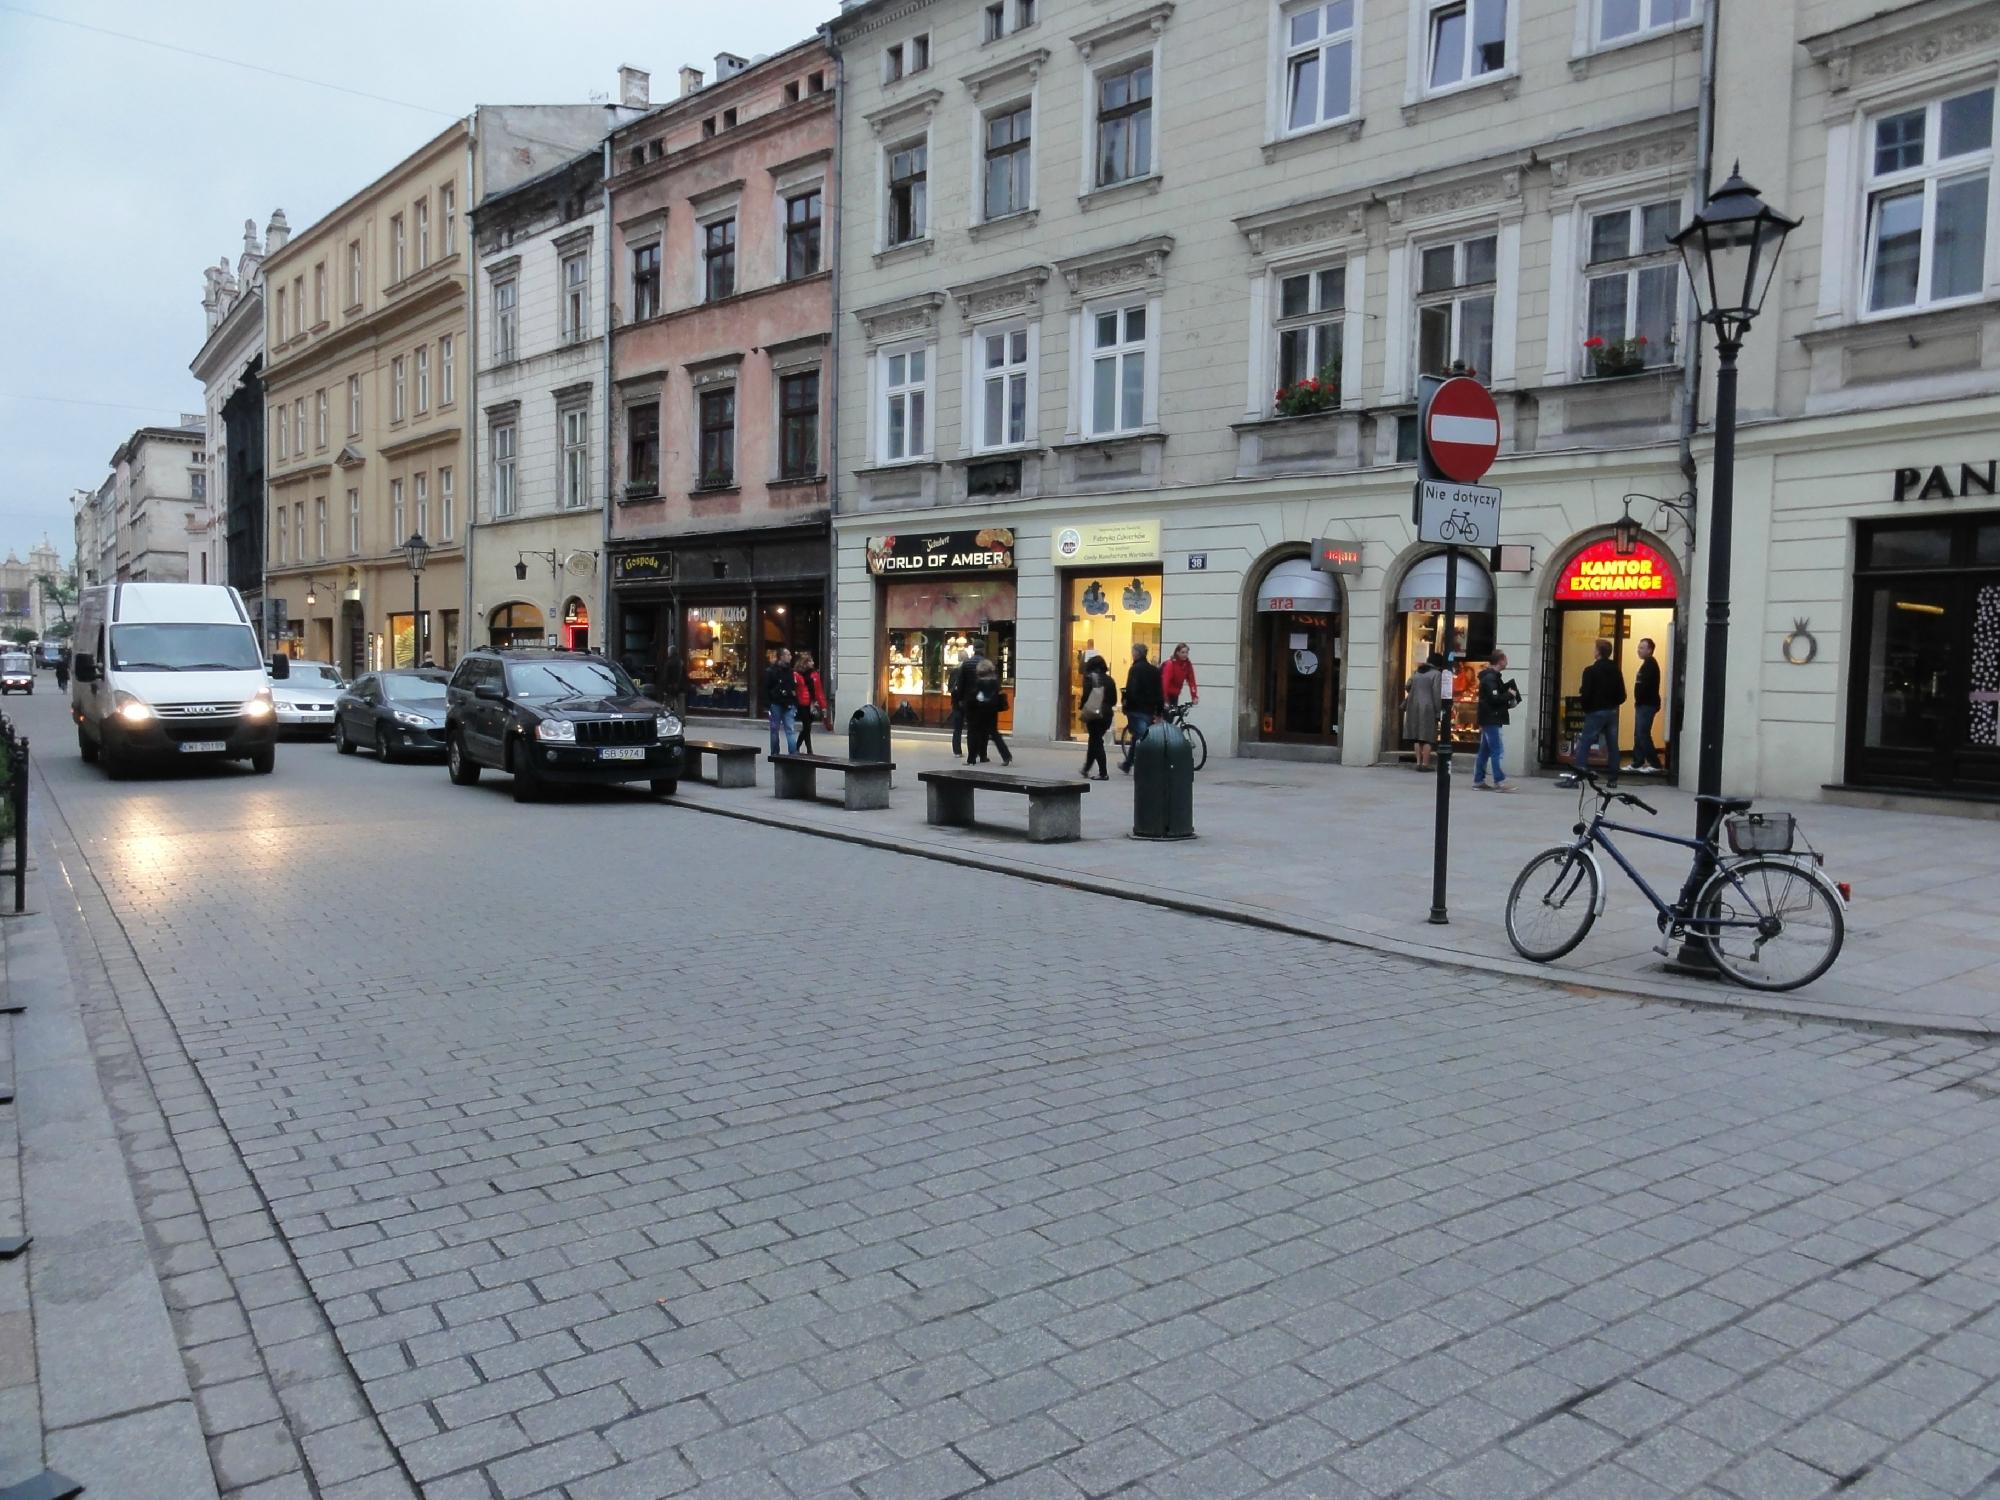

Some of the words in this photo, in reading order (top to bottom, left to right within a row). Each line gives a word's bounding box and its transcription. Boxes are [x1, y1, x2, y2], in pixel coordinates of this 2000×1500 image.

[1893, 460, 1997, 502] PAN
[1425, 486, 1446, 500] Nie
[1453, 489, 1497, 508] dotyczy
[625, 556, 657, 570] Gospoda
[875, 555, 923, 570] WORLD
[927, 554, 947, 567] OF
[951, 551, 1004, 566] AMBER
[1191, 558, 1202, 569] 38
[1581, 559, 1652, 575] KANTOR
[1570, 576, 1662, 591] EXCHANGE
[1270, 598, 1293, 610] ara
[1413, 597, 1440, 610] ara
[604, 750, 616, 759] SB
